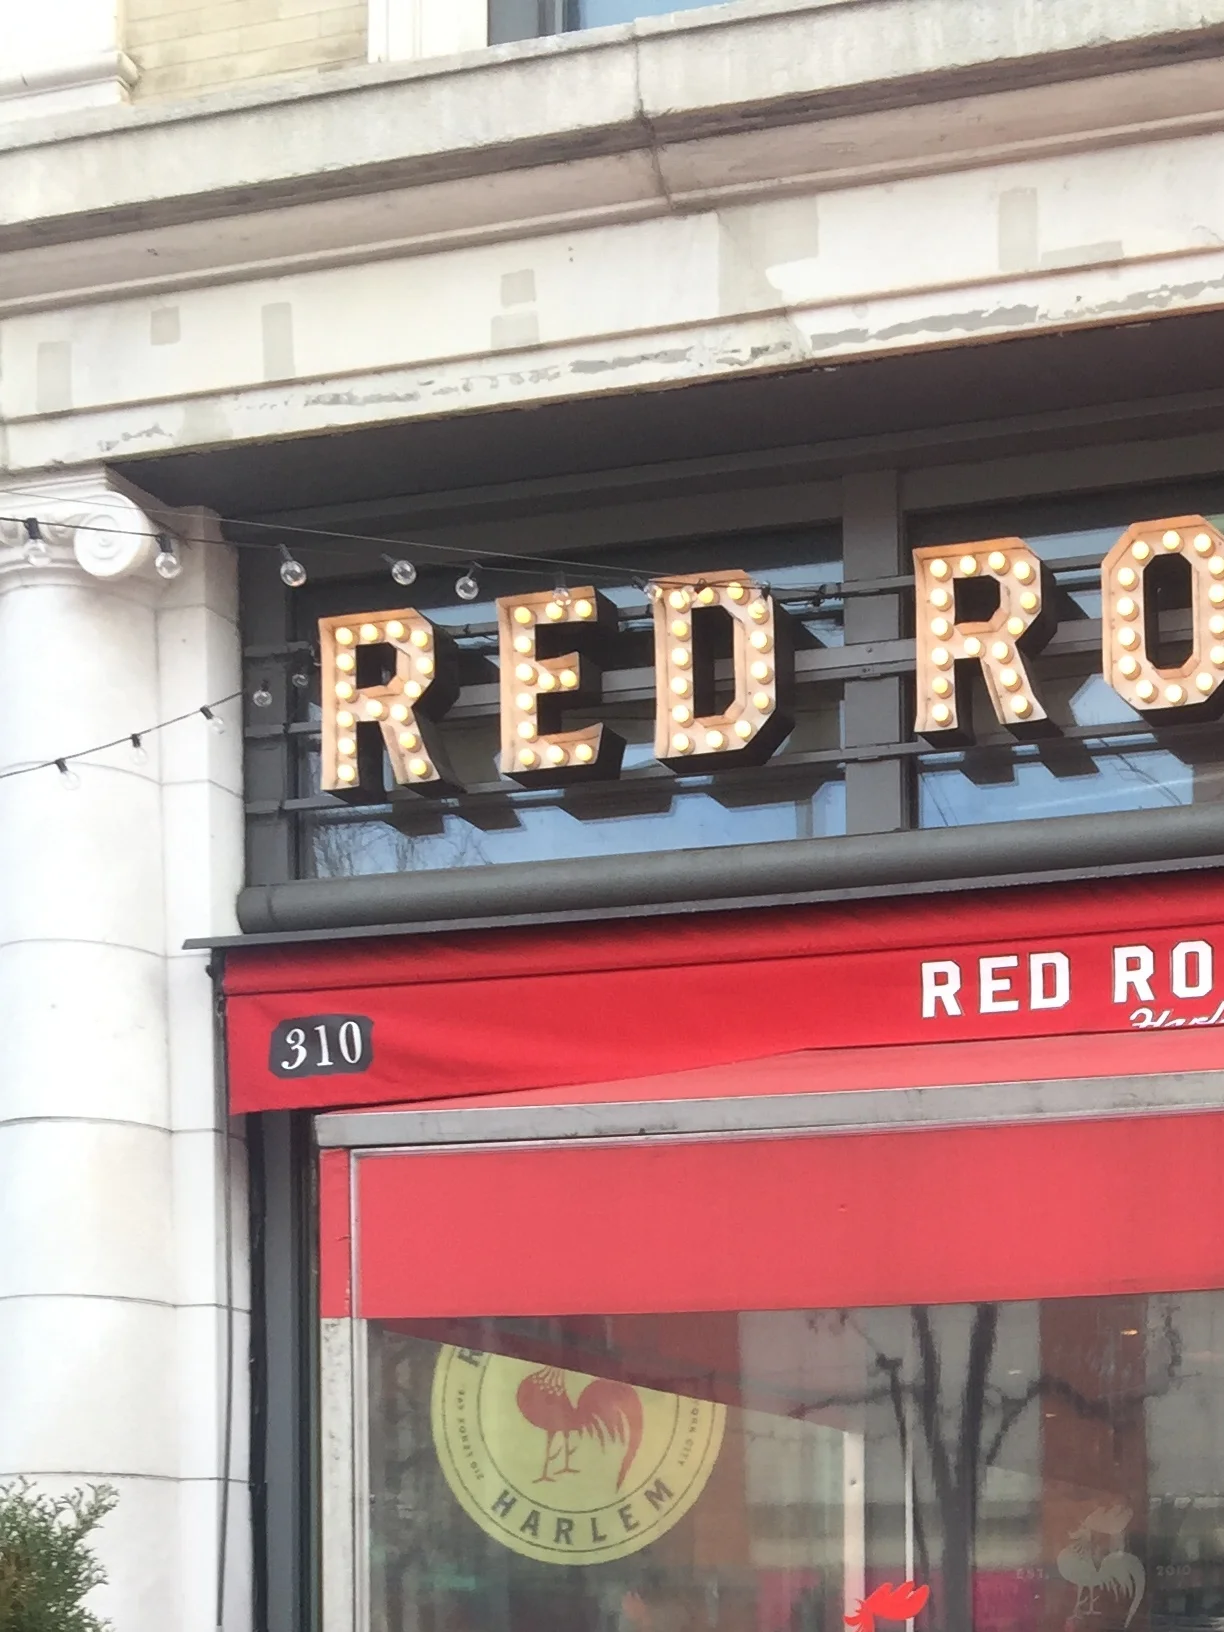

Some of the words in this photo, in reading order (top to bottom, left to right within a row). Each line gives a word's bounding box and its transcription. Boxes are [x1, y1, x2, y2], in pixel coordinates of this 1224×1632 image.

[318, 571, 790, 797] RED
[921, 951, 1071, 1019] RED
[280, 1021, 363, 1071] 310
[491, 1477, 675, 1546] HARLEM
